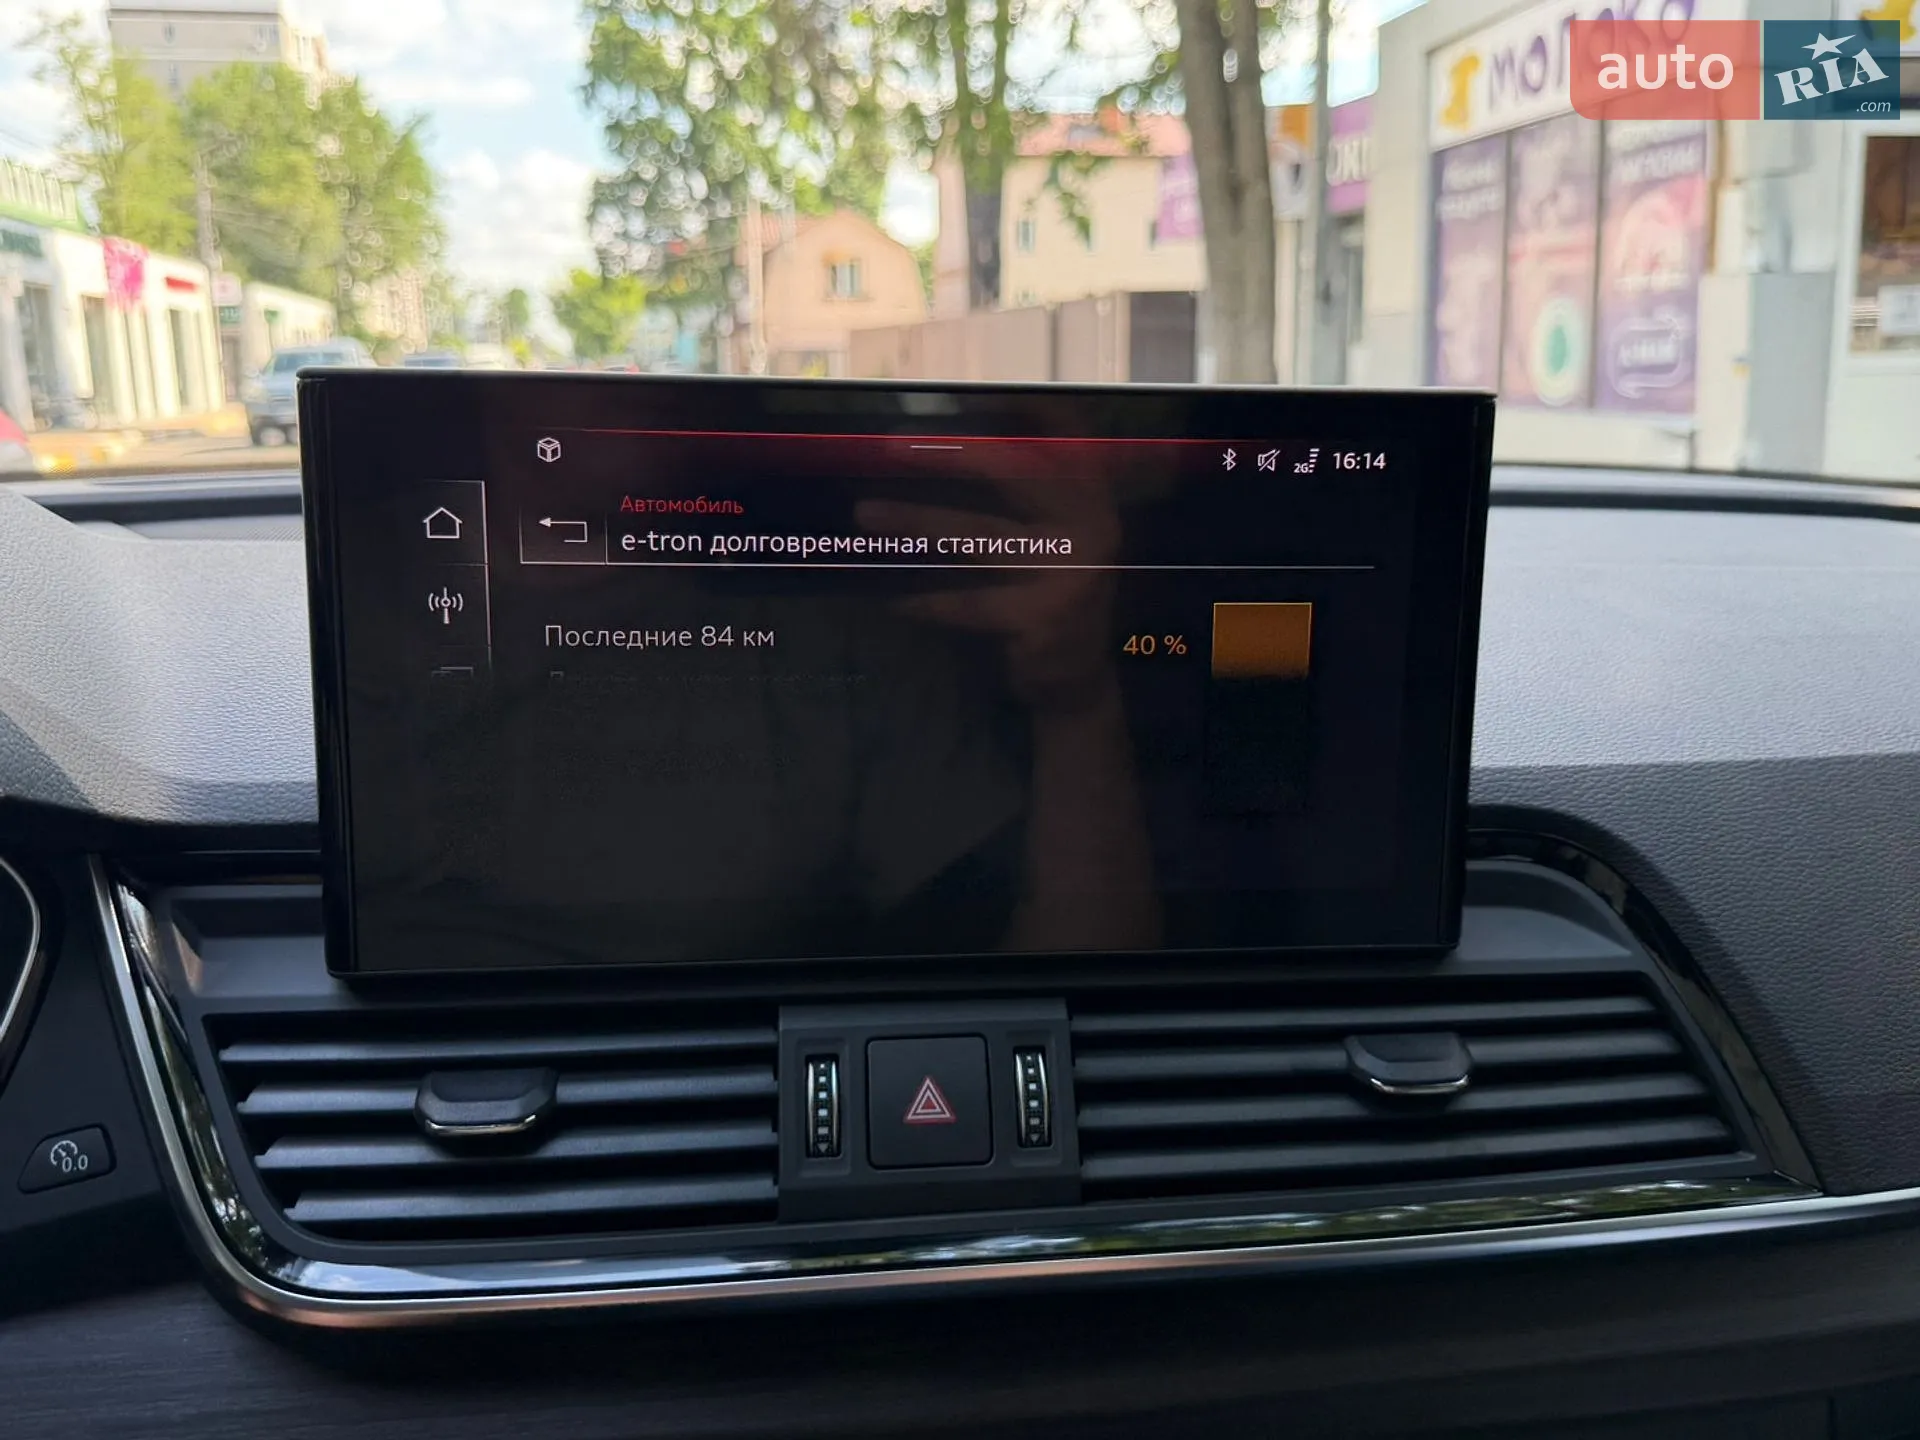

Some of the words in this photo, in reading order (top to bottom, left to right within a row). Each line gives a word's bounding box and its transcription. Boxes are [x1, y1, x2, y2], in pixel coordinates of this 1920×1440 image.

[1333, 452, 1387, 470] 16:14
[620, 495, 744, 514] Автомобиль
[621, 530, 702, 552] e-tron
[709, 534, 928, 558] долговременная
[937, 537, 1072, 555] статистика
[544, 624, 692, 649] Последние
[700, 625, 735, 647] 84
[743, 630, 775, 647] км
[1123, 634, 1156, 655] 40
[1163, 634, 1187, 655] %
